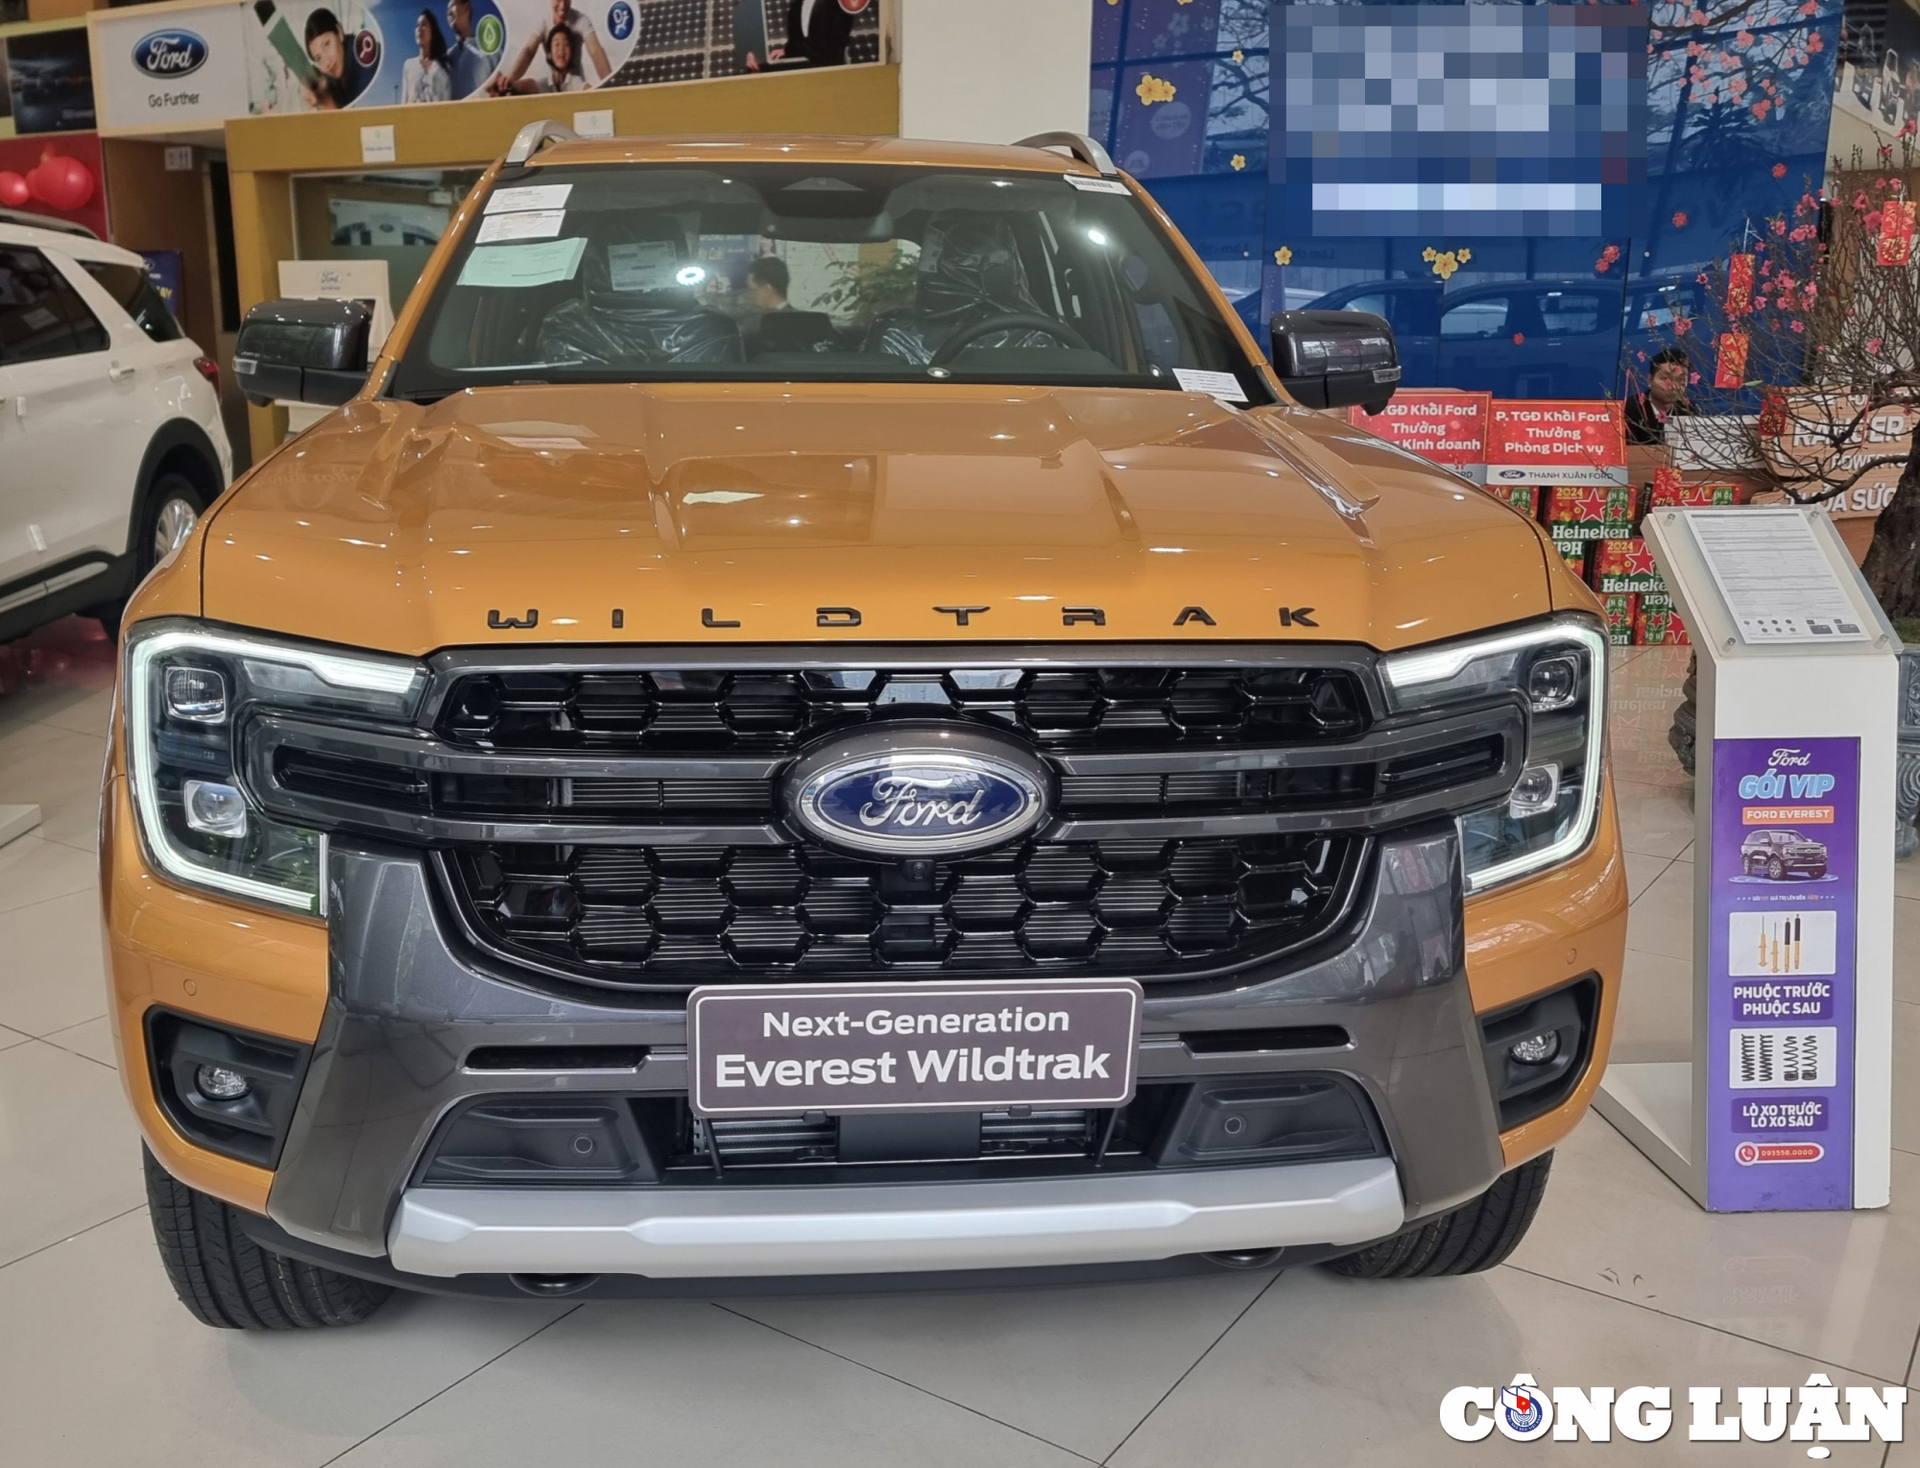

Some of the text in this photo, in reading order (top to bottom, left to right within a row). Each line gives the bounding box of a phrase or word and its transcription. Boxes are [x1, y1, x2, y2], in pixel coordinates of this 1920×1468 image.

[147, 37, 192, 70] Ford
[148, 92, 199, 107] Go Further
[1445, 404, 1477, 416] Ford
[1496, 411, 1509, 421] P.
[1511, 411, 1541, 422] TGĐ
[1578, 411, 1610, 422] Ford
[1402, 439, 1481, 451] Kinh doanh
[1505, 442, 1604, 455] Phòng Dịch vụ
[1589, 472, 1614, 480] FORD
[1556, 487, 1583, 497] 2024
[1552, 525, 1629, 539] Heineken
[1553, 541, 1583, 556] Hei
[1607, 541, 1633, 551] 2024
[487, 606, 1320, 629] WILDTRAK
[1768, 748, 1811, 766] Ford
[1738, 768, 1835, 799] GÓI VIP
[859, 776, 984, 827] Ford
[1747, 809, 1830, 819] FORD EVEREST
[1733, 982, 1830, 1001] PHUỘC TRƯỚC
[1743, 1000, 1821, 1017] PHUỘC SAU
[763, 1006, 1070, 1038] Next-Generation
[716, 1045, 1111, 1088] Everest Wildtrak
[1761, 1105, 1778, 1116] XO
[1780, 1101, 1822, 1116] TRƯỚC
[1769, 1116, 1787, 1128] XO
[1788, 1116, 1814, 1127] SAU
